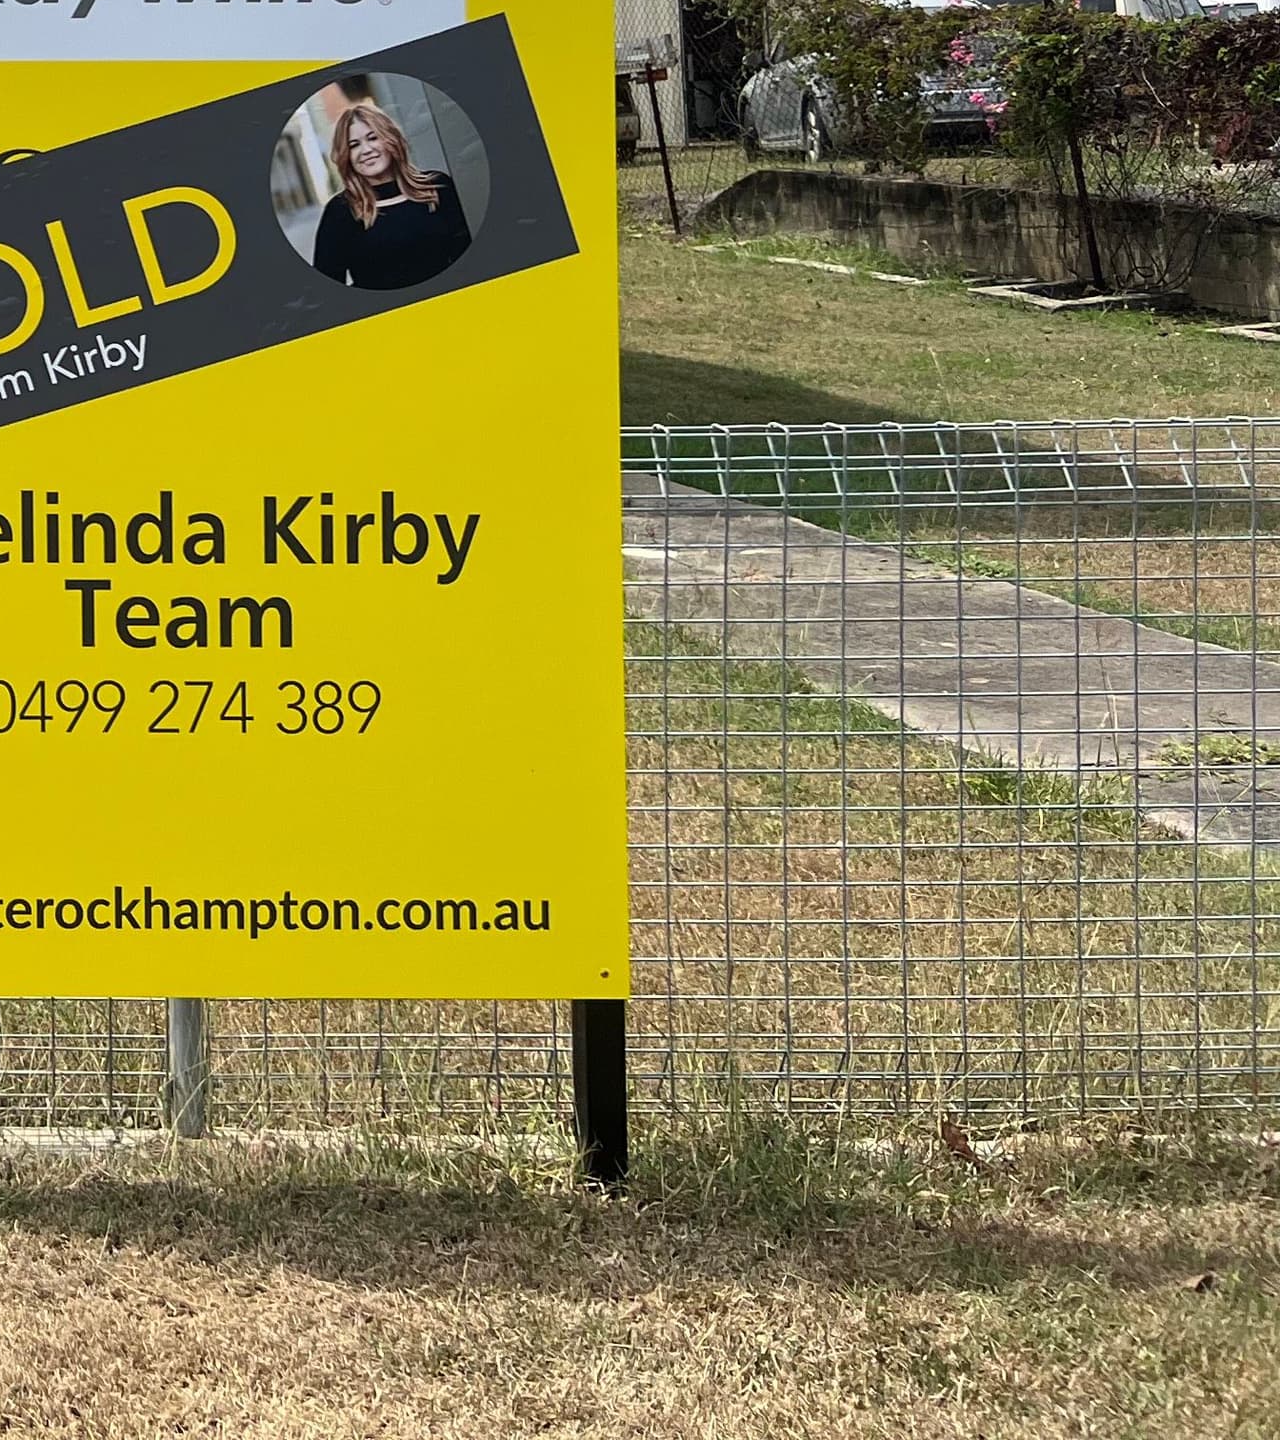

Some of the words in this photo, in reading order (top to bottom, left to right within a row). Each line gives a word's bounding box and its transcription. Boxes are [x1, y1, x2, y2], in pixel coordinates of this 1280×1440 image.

[42, 333, 148, 385] Kirby
[262, 490, 481, 585] Kirby
[64, 578, 295, 650] Team
[146, 678, 255, 736] 274
[276, 678, 383, 736] 389
